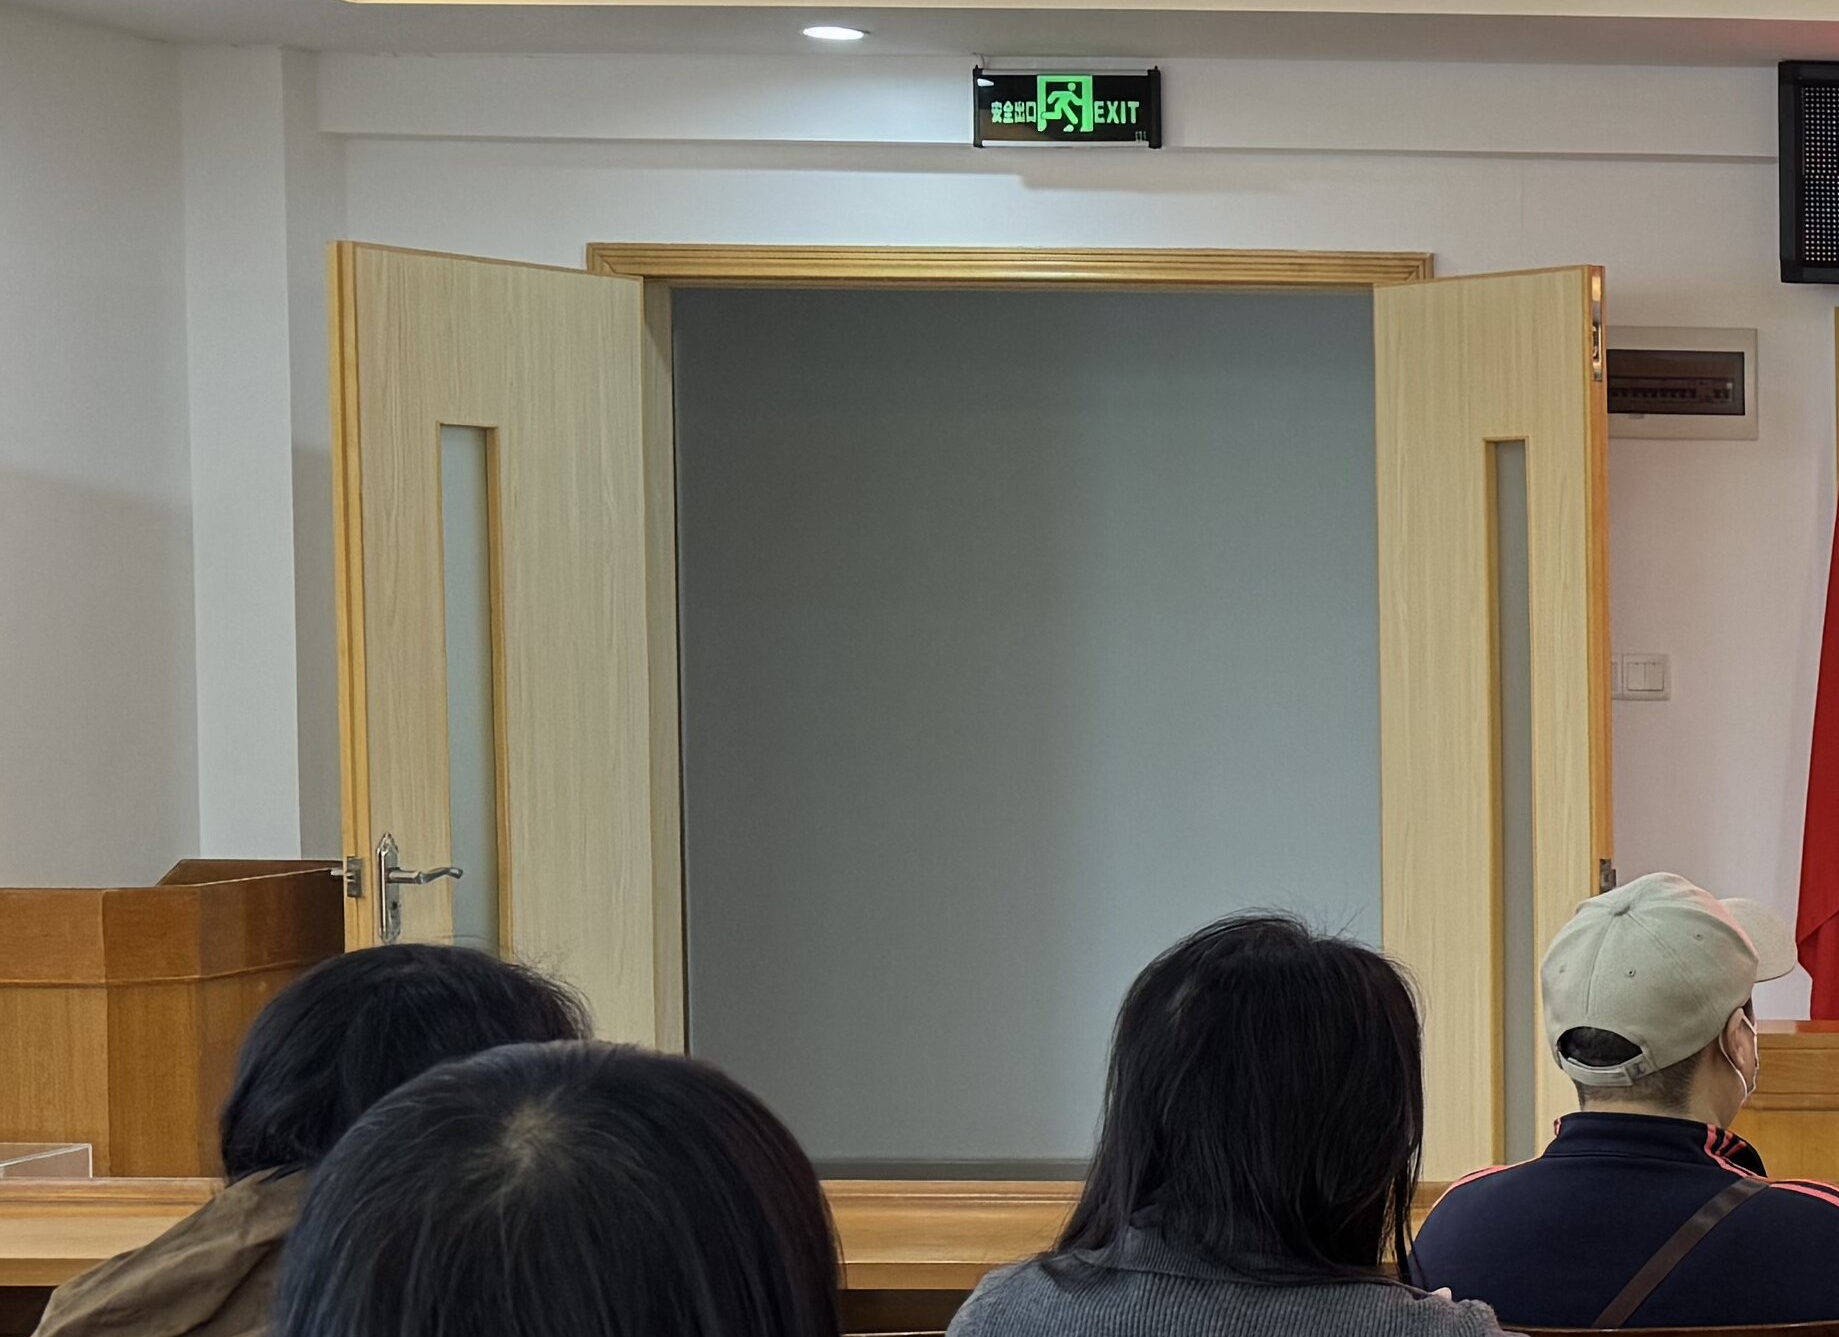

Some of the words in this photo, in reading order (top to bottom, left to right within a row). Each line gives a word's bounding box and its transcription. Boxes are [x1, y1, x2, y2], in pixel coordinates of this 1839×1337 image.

[990, 100, 1037, 124] 安全出口
[1094, 100, 1140, 125] EXIT
